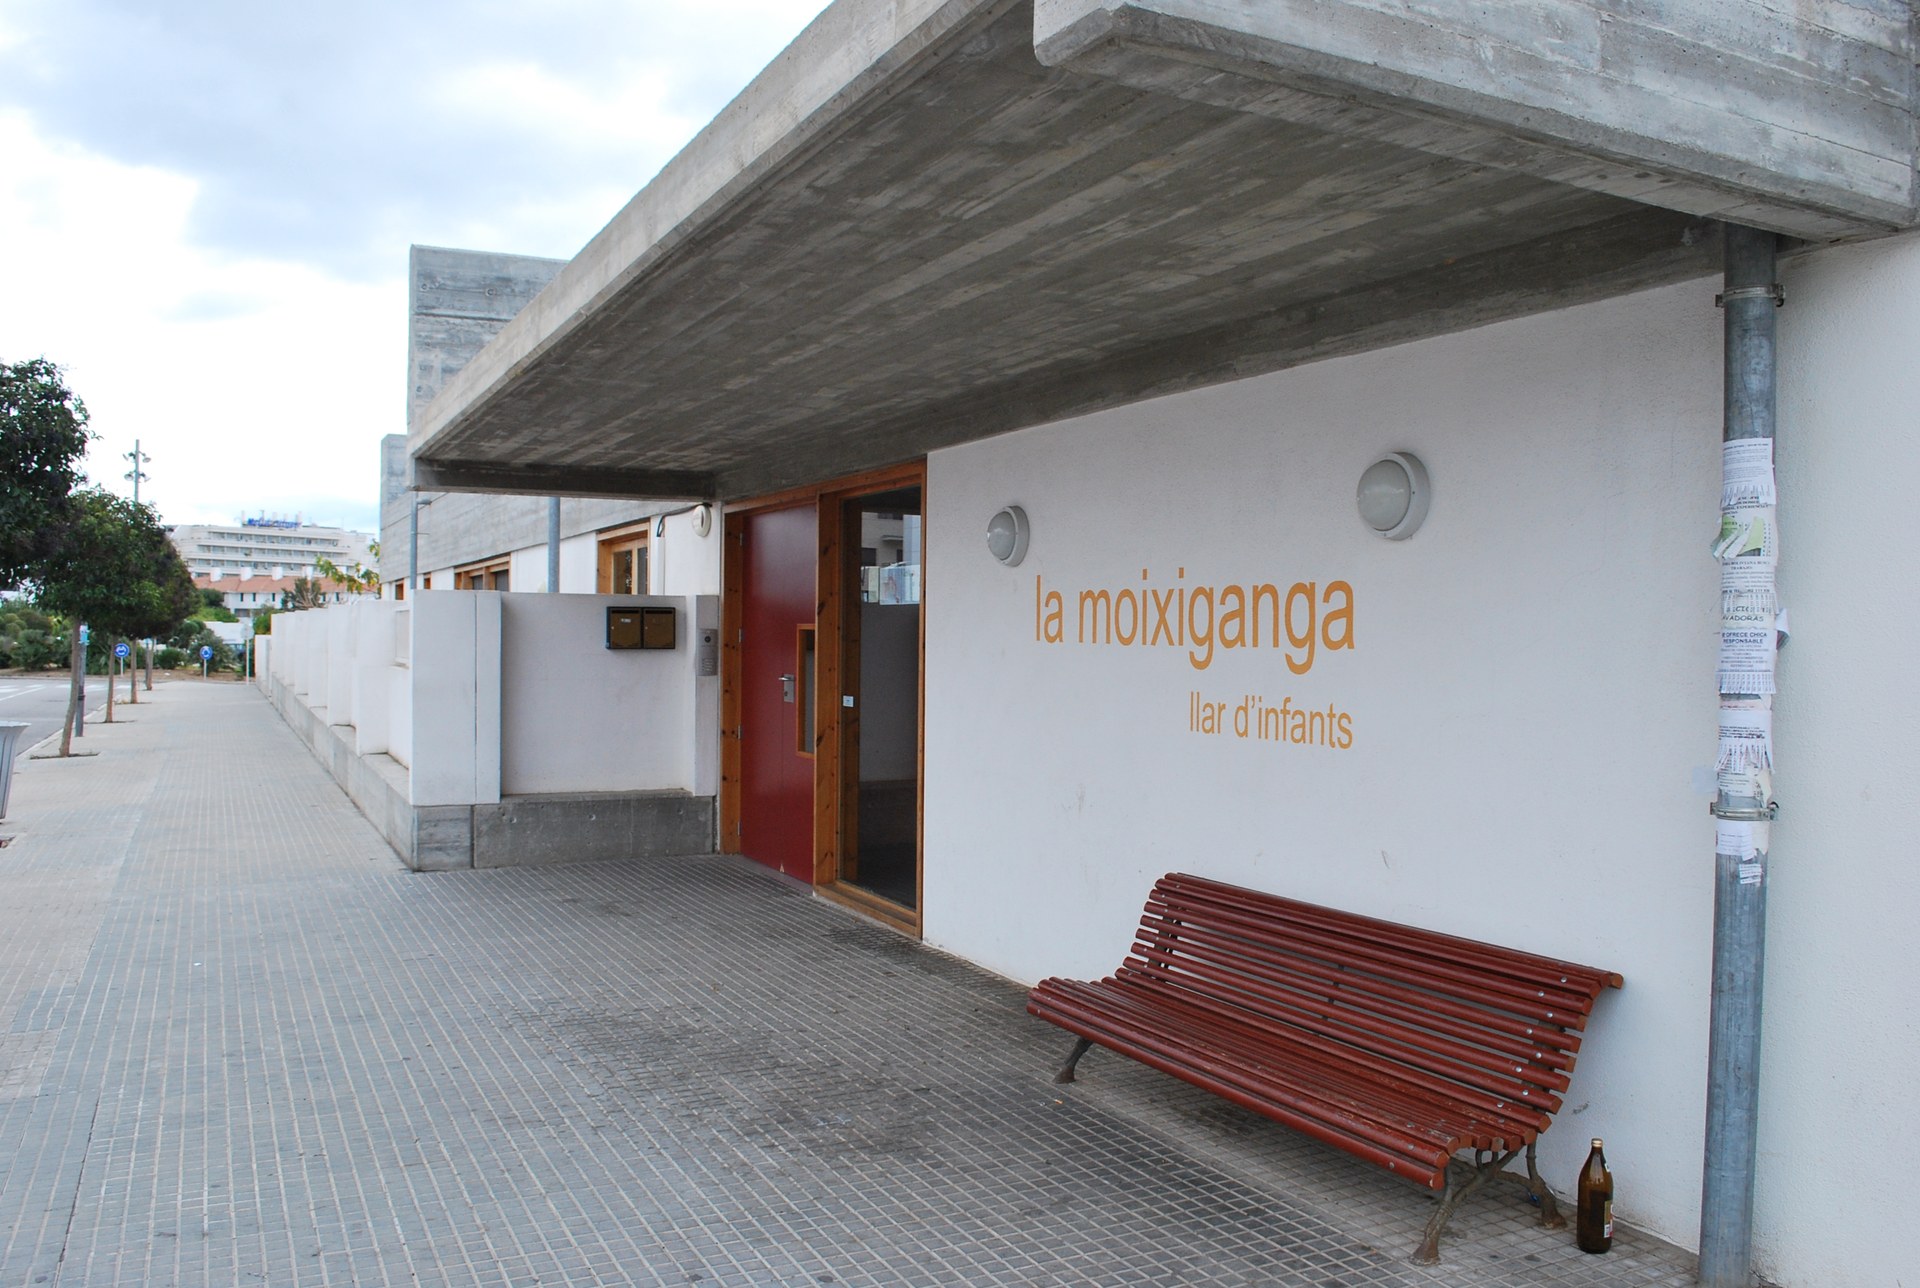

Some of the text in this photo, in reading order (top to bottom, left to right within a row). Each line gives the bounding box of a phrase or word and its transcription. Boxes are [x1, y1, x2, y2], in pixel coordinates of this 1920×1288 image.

[1036, 567, 1355, 675] la moixiganga
[1190, 691, 1353, 749] llar d'infants
